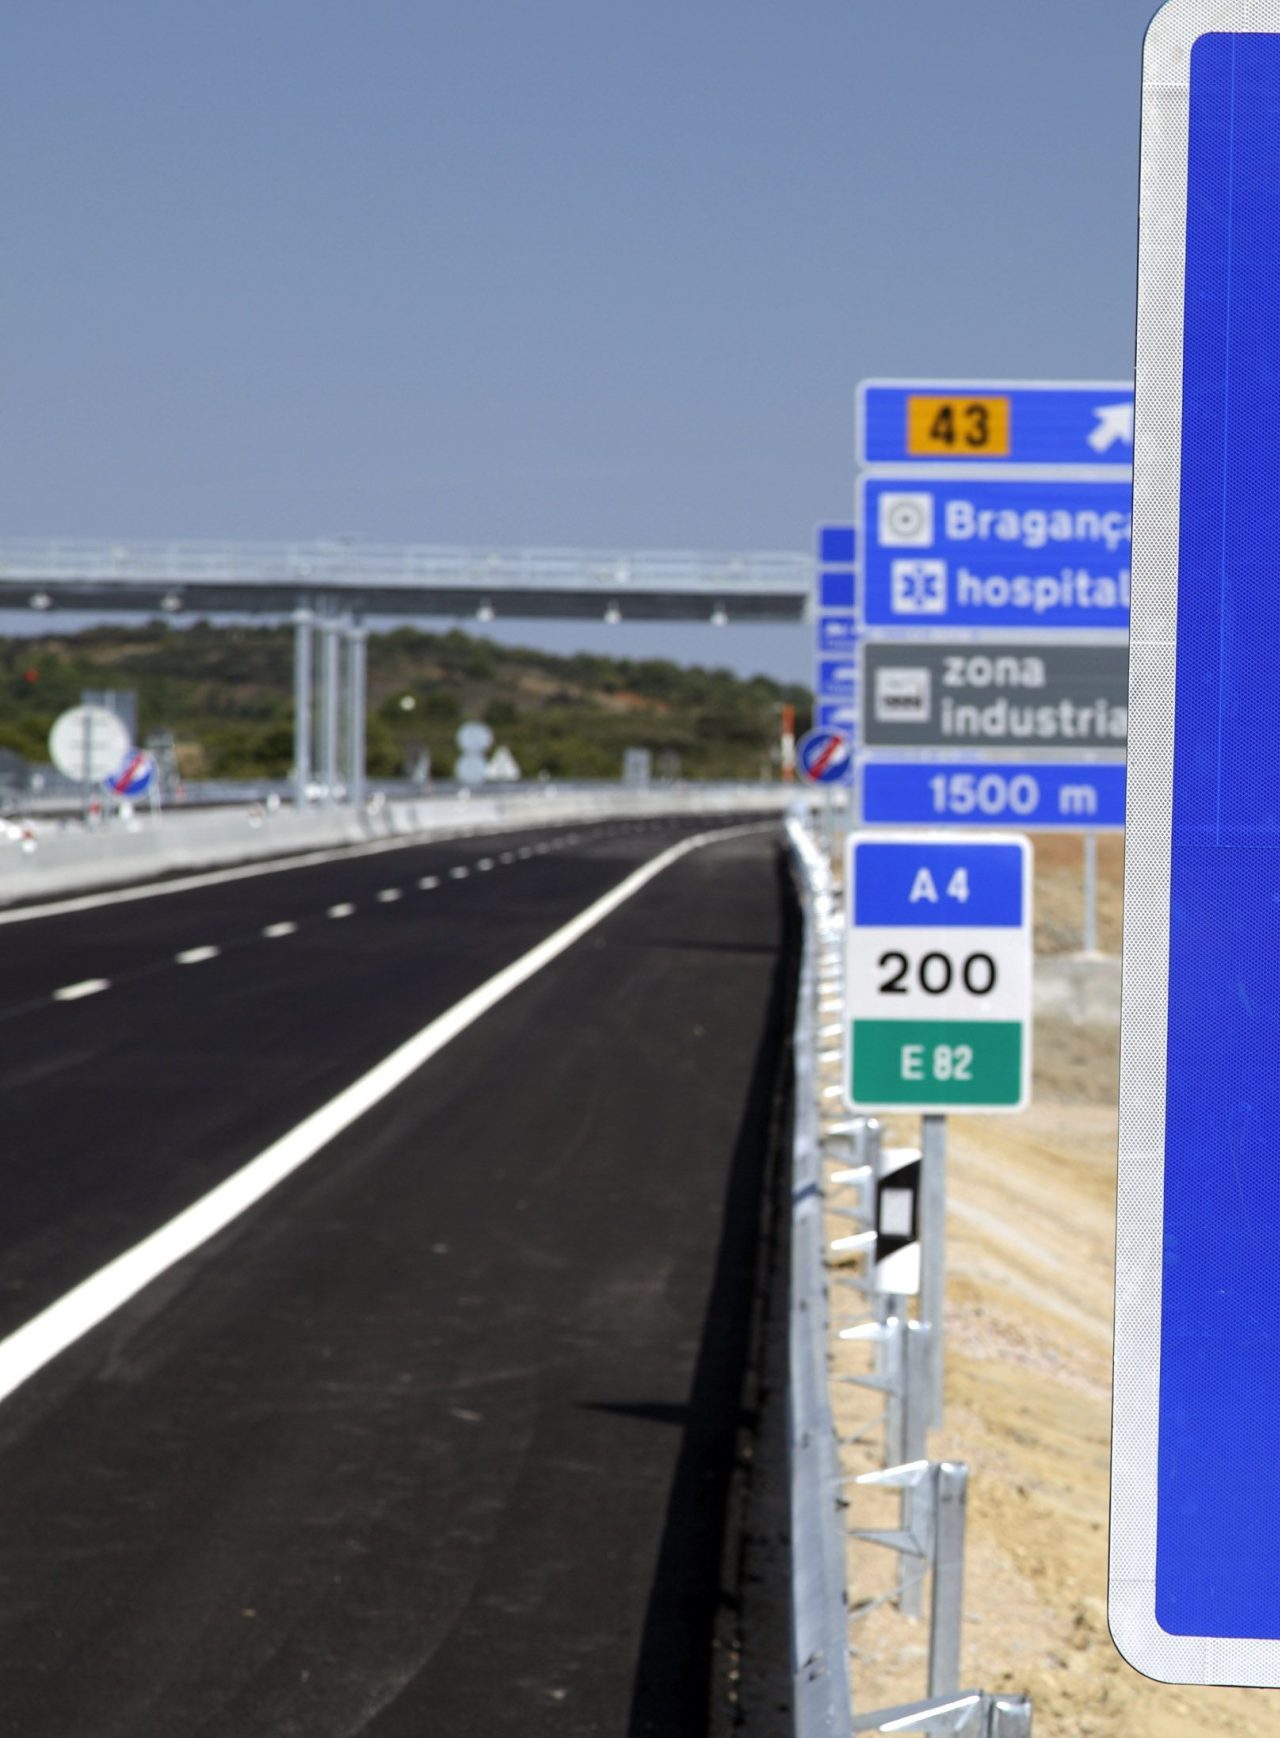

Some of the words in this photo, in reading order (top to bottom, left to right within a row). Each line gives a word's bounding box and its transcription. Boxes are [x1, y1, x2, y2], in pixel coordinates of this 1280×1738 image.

[929, 404, 991, 448] 43
[942, 655, 1045, 688] zona
[929, 775, 1039, 814] 1500
[1060, 785, 1097, 813] m
[877, 951, 996, 995] 200
[901, 1046, 924, 1080] E
[934, 1045, 973, 1081] 82
